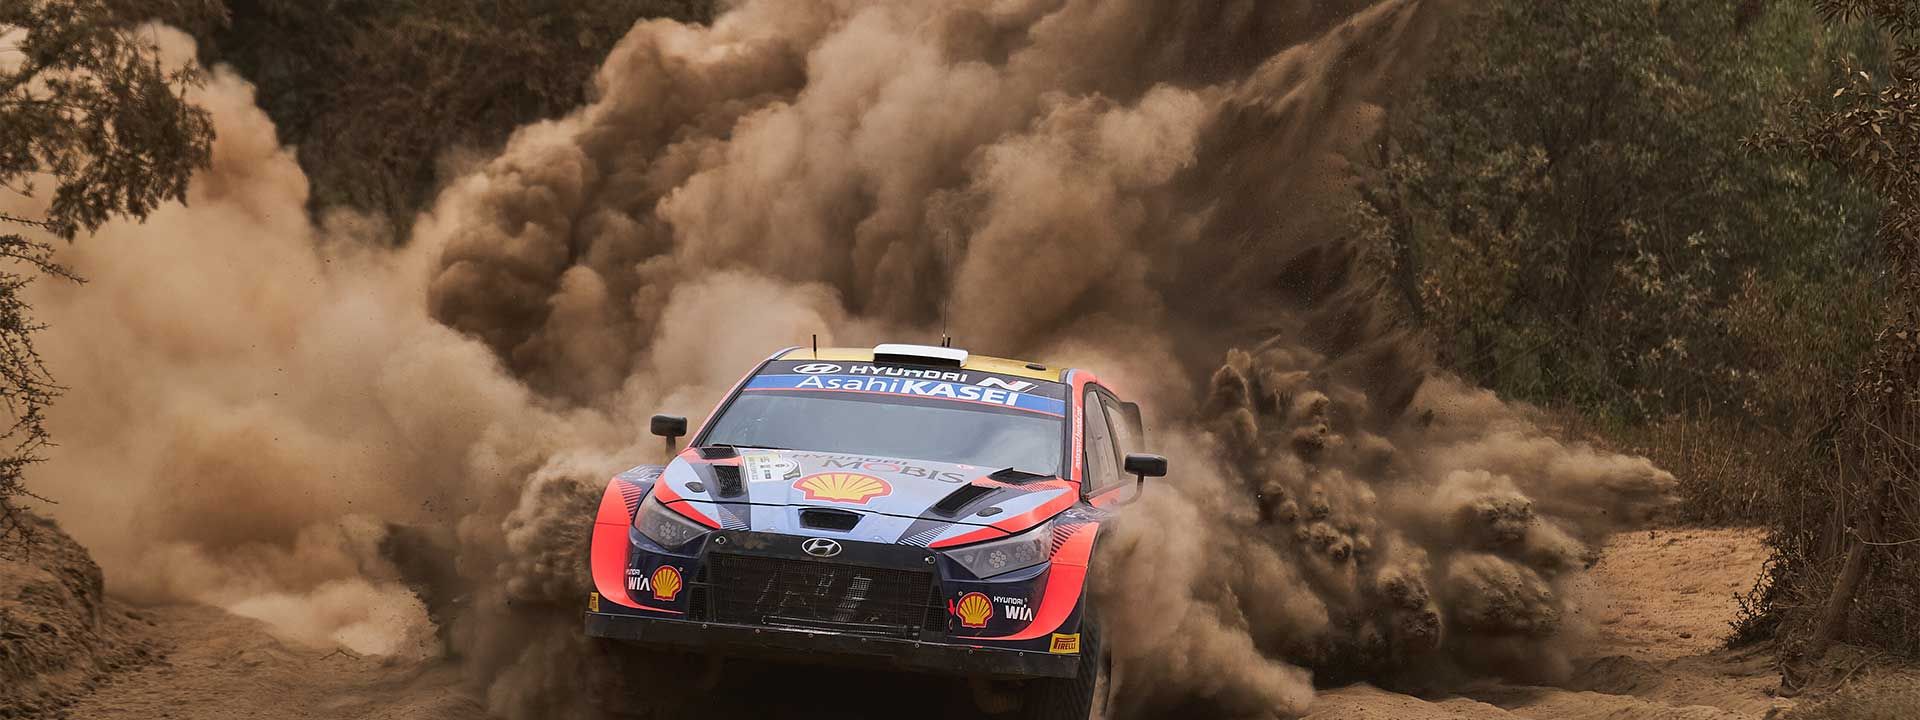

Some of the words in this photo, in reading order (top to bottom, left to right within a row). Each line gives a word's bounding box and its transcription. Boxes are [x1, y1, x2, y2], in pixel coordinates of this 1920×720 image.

[849, 364, 969, 383] HYUNDAI
[820, 459, 966, 484] MOBIS
[628, 574, 650, 591] WIA
[994, 596, 1023, 605] HYUNDAI
[1005, 604, 1033, 621] WIA
[1053, 638, 1076, 650] PIRELLI
